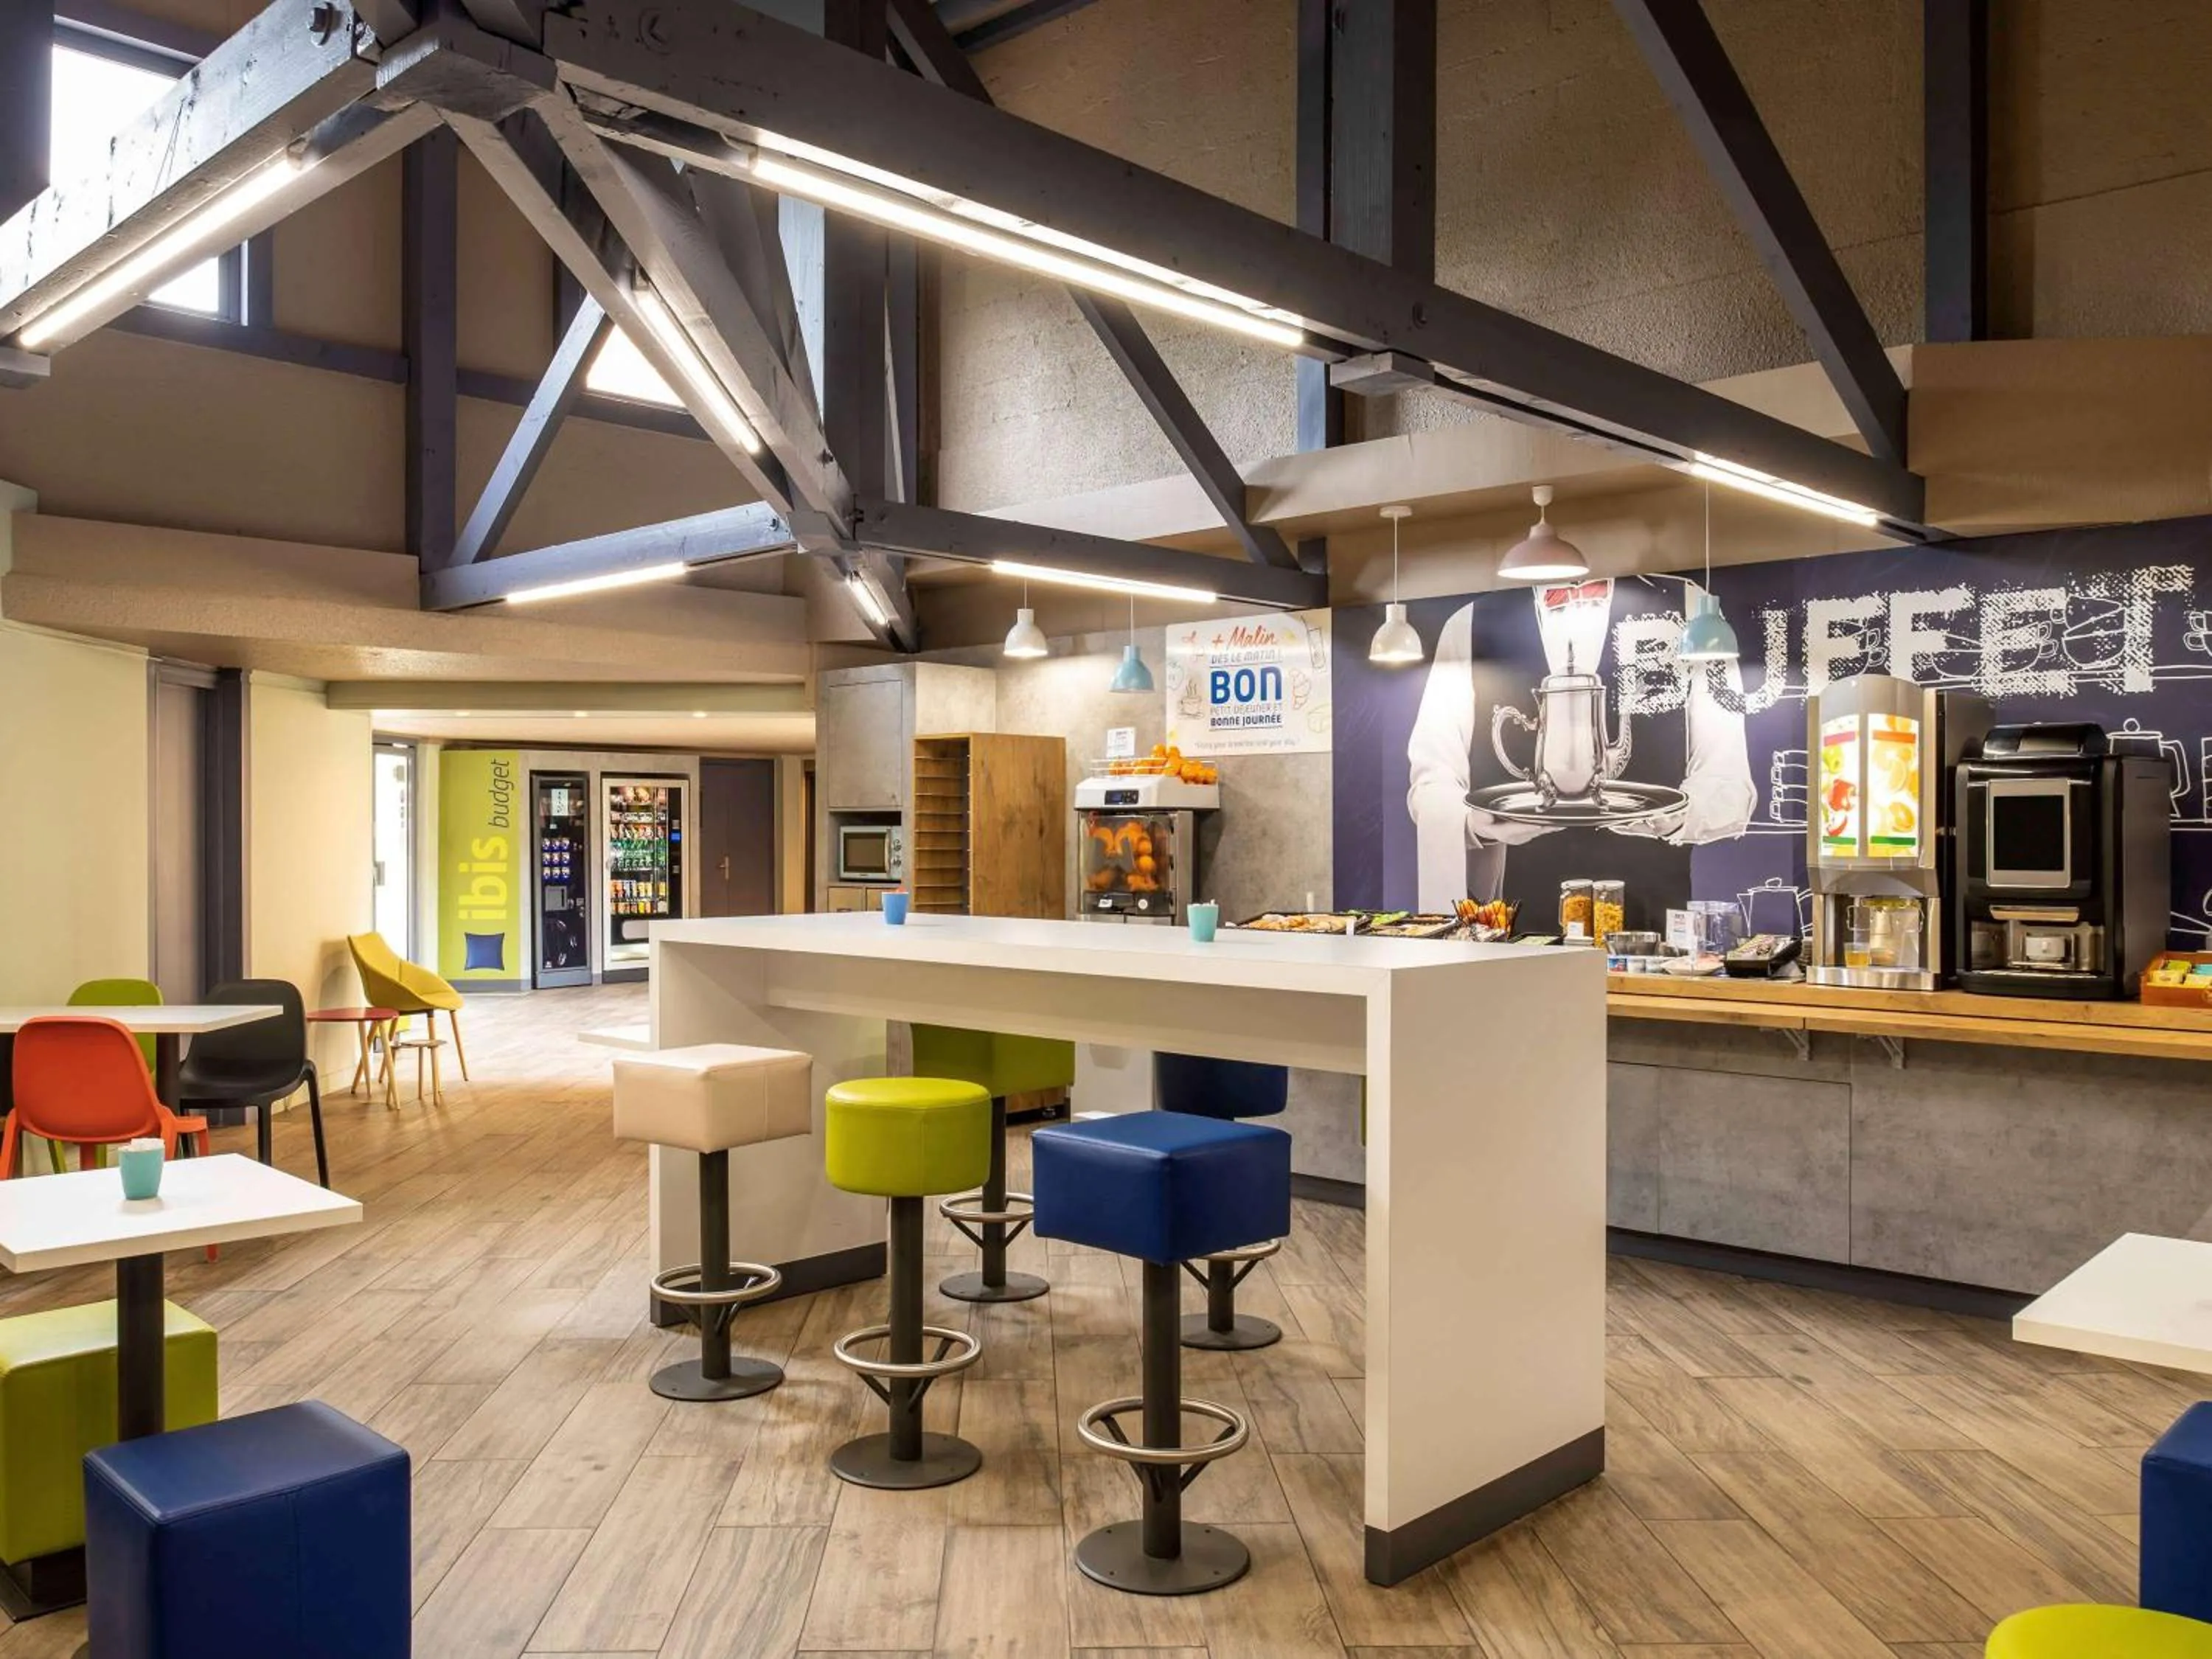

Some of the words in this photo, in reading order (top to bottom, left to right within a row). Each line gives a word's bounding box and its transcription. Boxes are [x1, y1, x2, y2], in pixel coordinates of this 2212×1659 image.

[1227, 625, 1277, 649] Malin
[1613, 564, 2194, 717] BUFFET
[1231, 652, 1242, 663] LE
[1210, 667, 1282, 704] BON
[1210, 717, 1239, 726] BONNE
[458, 836, 508, 919] ibis
[487, 758, 515, 829] budget
